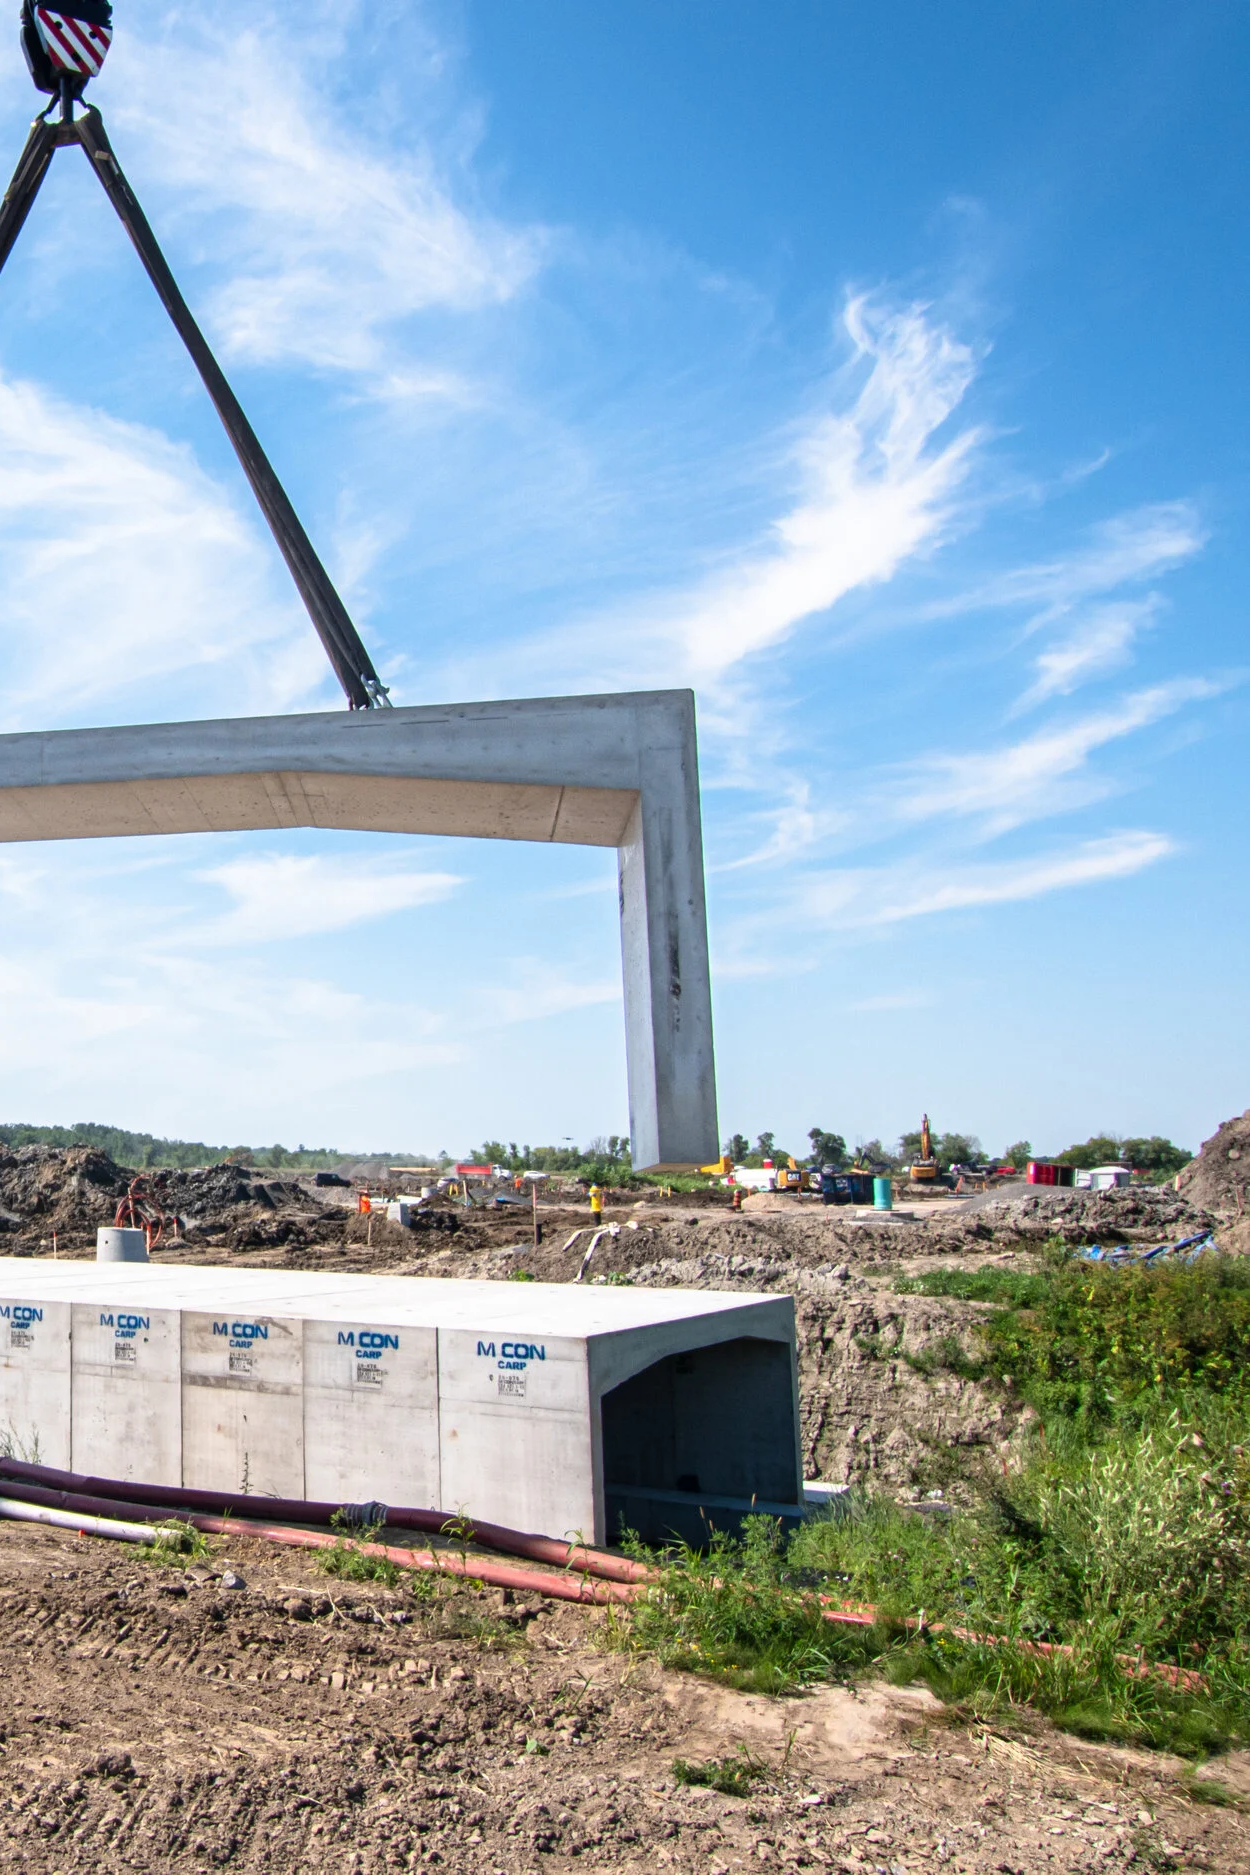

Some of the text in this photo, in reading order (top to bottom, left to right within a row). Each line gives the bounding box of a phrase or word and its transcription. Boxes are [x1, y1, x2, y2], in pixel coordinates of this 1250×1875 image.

[13, 1306, 42, 1322] CON
[12, 1321, 31, 1329] CARP
[100, 1314, 149, 1330] M CON
[115, 1330, 136, 1338] CARP
[214, 1323, 268, 1338] M CON
[230, 1340, 252, 1349] CARP
[338, 1332, 398, 1351] M CON
[356, 1350, 381, 1359] CARP
[477, 1341, 546, 1361] M CON
[498, 1359, 526, 1370] CARP
